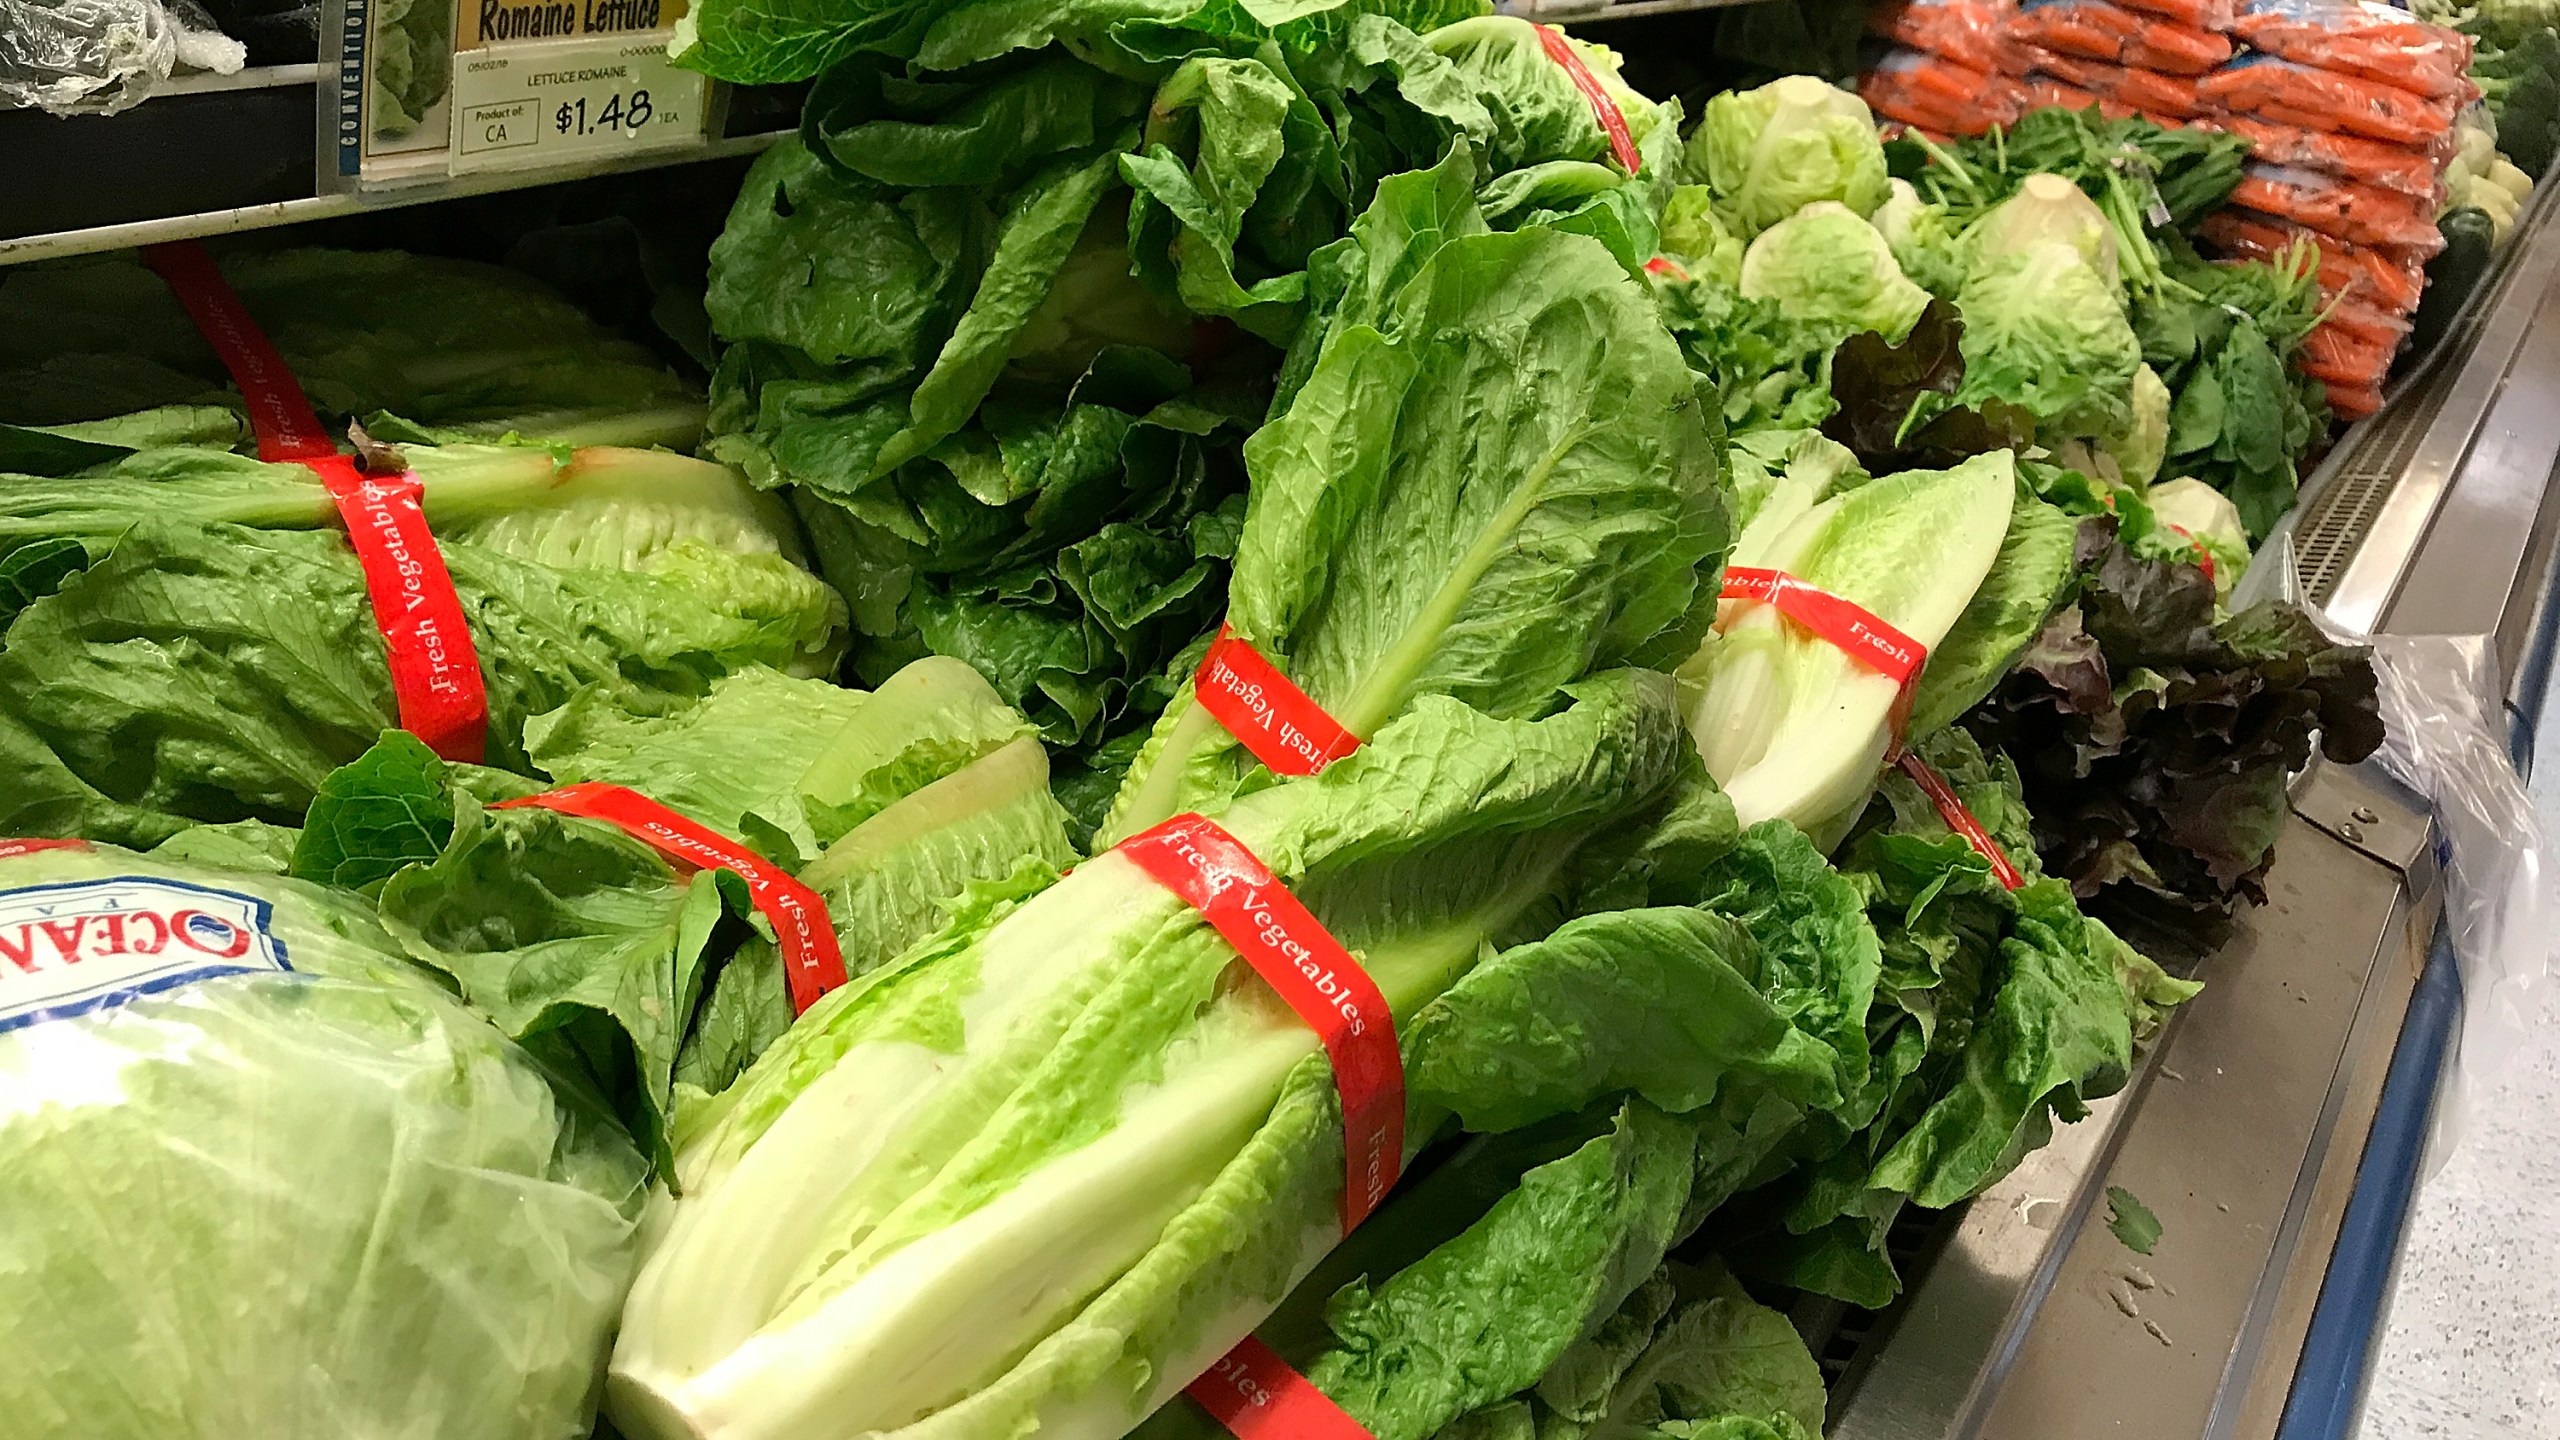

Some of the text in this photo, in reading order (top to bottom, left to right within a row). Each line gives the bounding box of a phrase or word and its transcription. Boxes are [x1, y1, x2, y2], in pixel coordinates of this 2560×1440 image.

[478, 0, 660, 41] Romaine Lettuce
[528, 66, 627, 87] LETTUCE ROMAINE
[476, 108, 510, 121] Product
[486, 124, 507, 142] CA
[556, 90, 652, 135] $1.48
[415, 618, 454, 693] Fresh
[1850, 620, 1910, 664] Fresh
[643, 821, 820, 969] Fresh Vegetables
[1161, 829, 1366, 1038] Fresh Vegetables
[1367, 1125, 1388, 1210] Fresh
